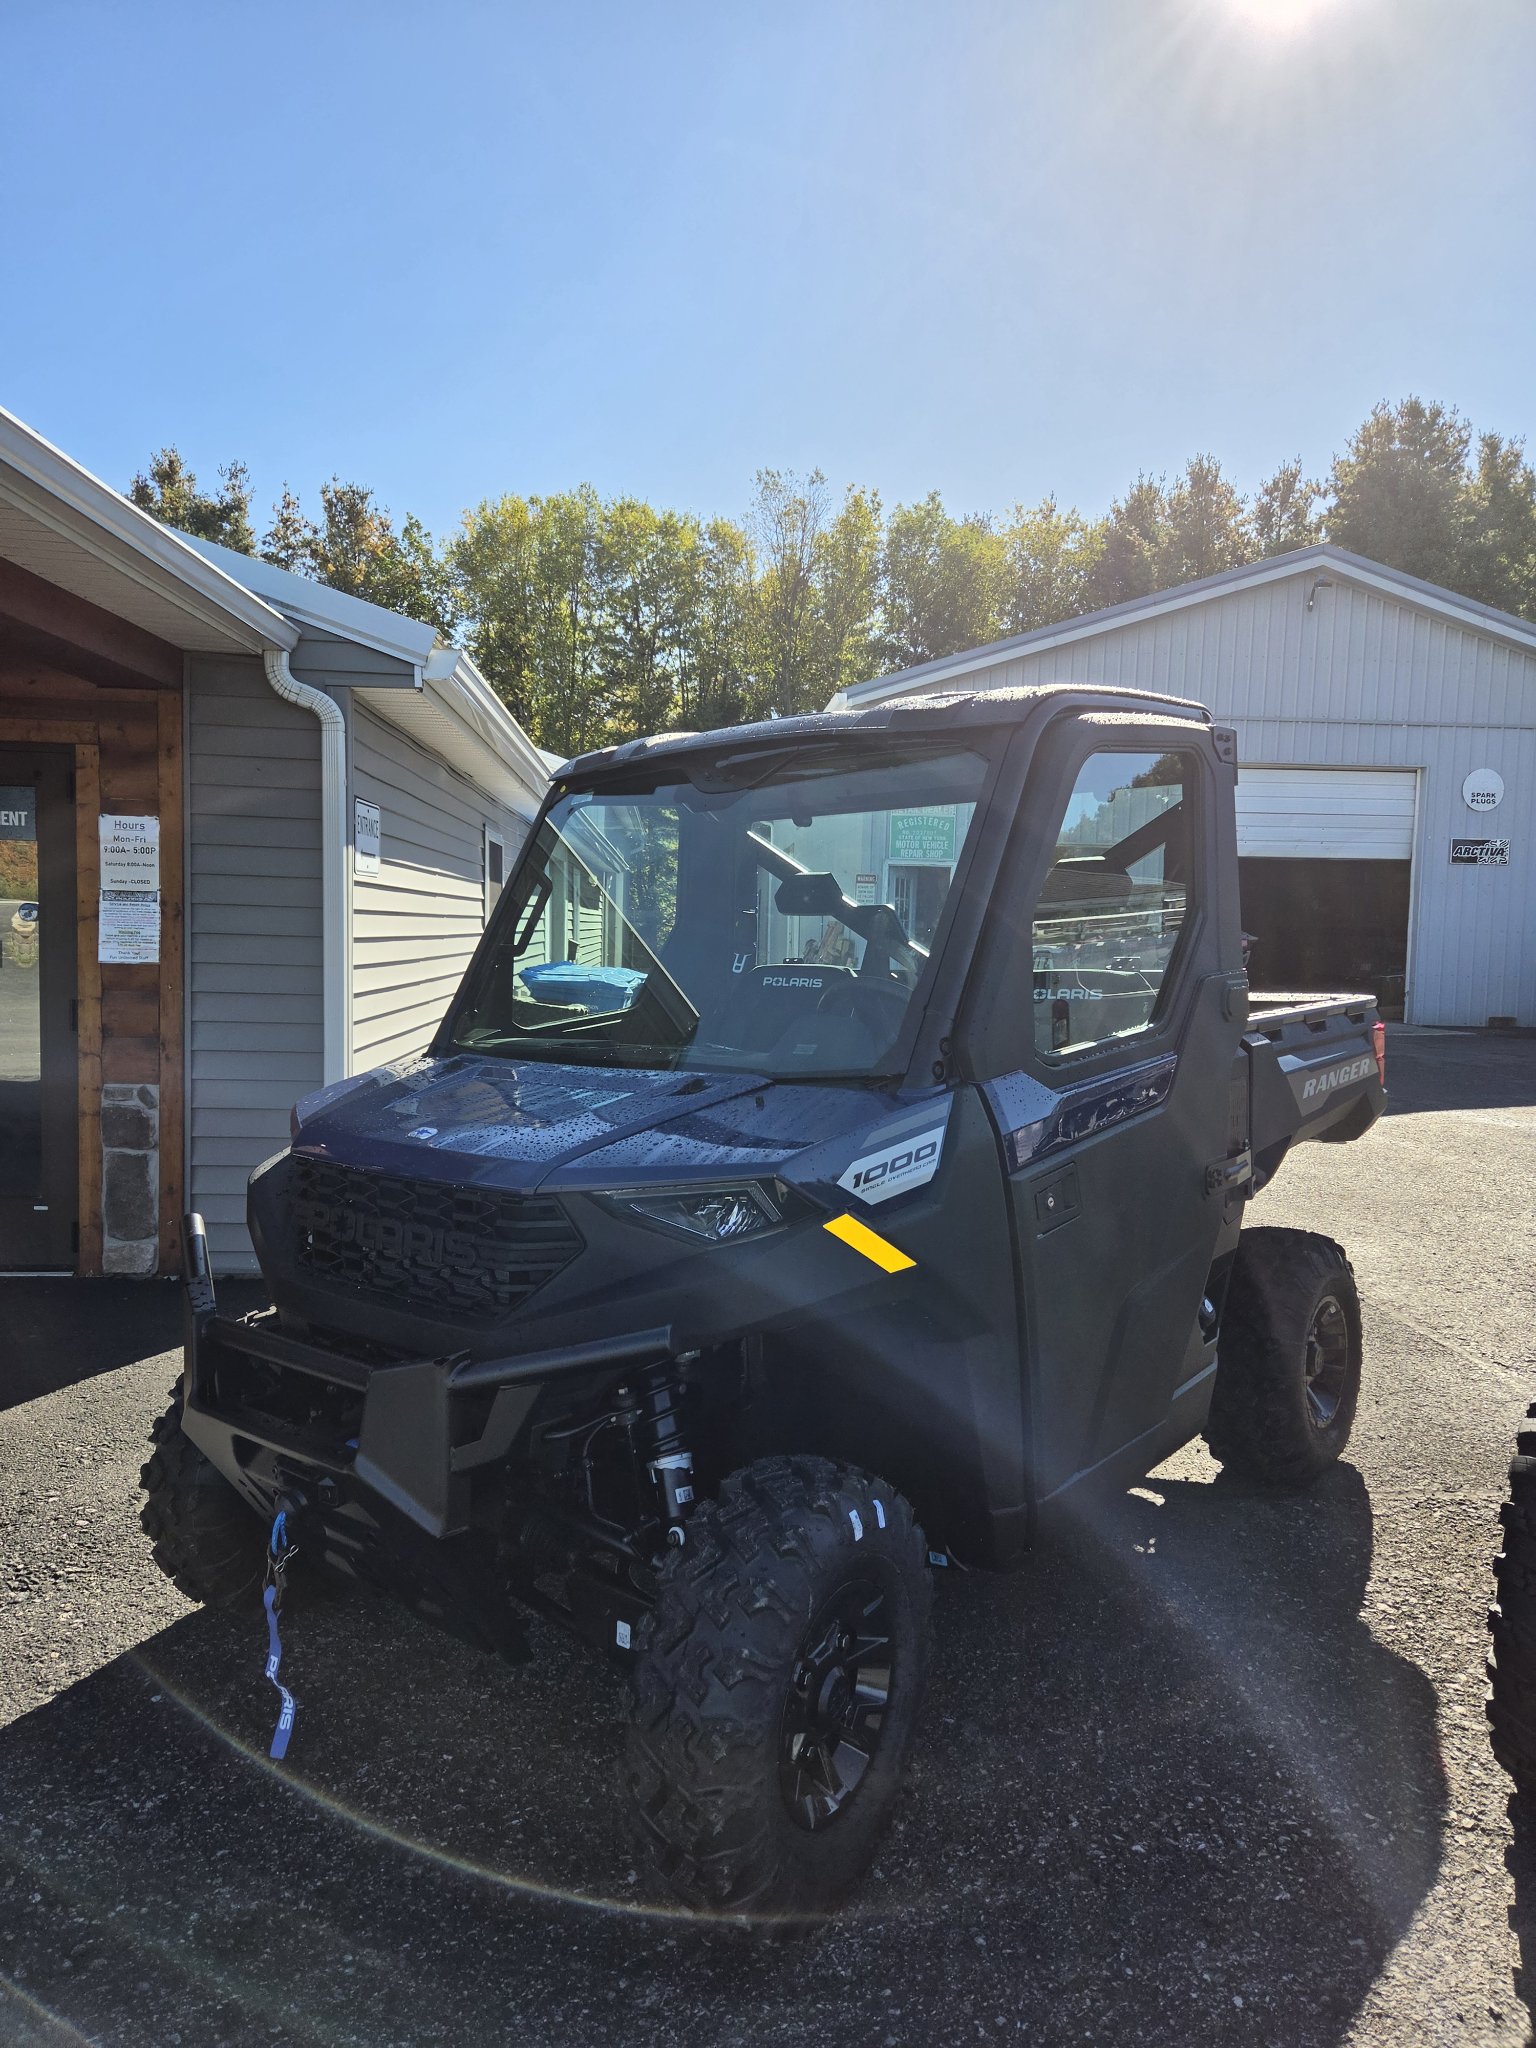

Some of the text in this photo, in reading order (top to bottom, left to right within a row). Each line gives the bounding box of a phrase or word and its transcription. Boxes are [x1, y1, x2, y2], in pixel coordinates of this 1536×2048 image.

[114, 820, 146, 831] Hours
[357, 814, 379, 839] ENTRANCE
[897, 816, 950, 831] REGISTERED
[113, 835, 146, 843] Mon-Fri
[896, 840, 949, 850] MOTOR VEHICLE
[133, 846, 156, 854] 5:00P
[900, 849, 944, 859] REPAIR SHOP
[1453, 846, 1505, 857] ARCTIVA
[762, 976, 823, 988] POLARIS
[1033, 988, 1103, 1000] OLARIS
[1302, 1057, 1370, 1099] RANGER
[853, 1141, 937, 1189] 1000
[861, 1181, 886, 1194] SINGLE
[887, 1165, 922, 1183] OVERHEAD
[295, 1202, 477, 1268] POLARIS
